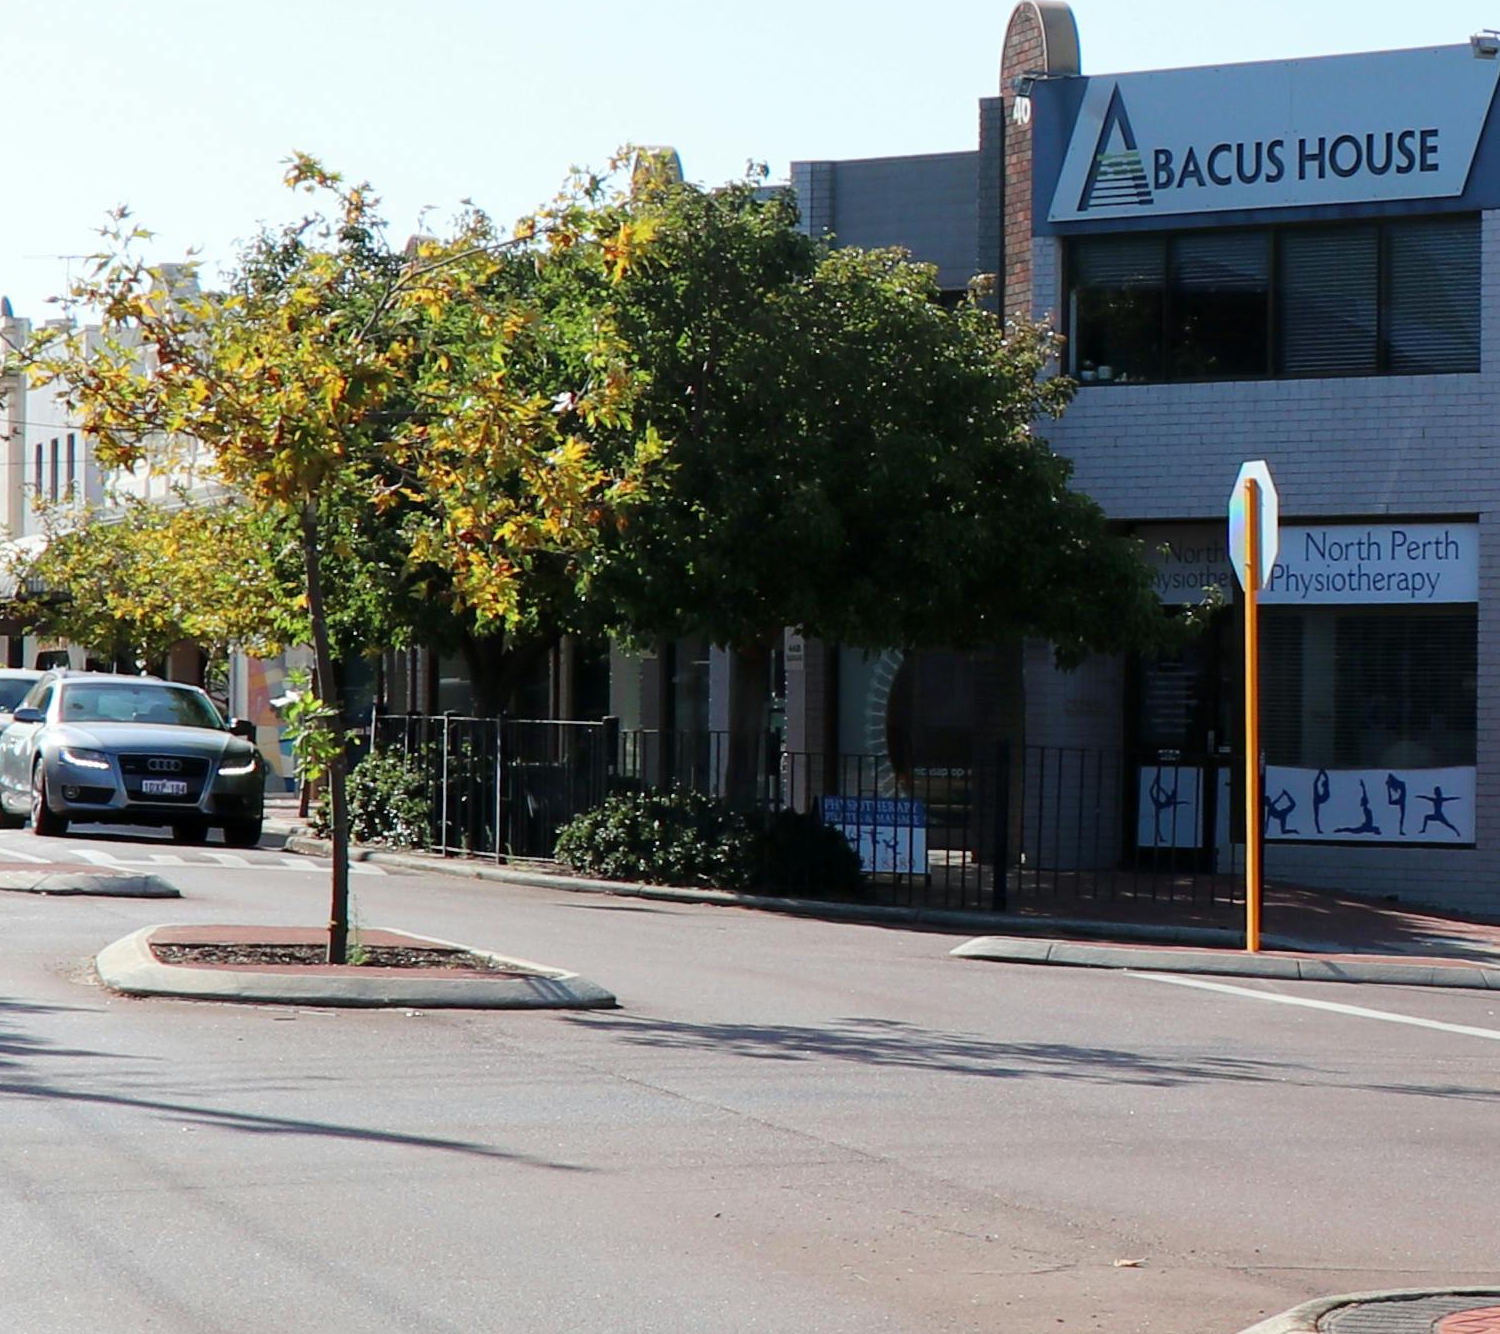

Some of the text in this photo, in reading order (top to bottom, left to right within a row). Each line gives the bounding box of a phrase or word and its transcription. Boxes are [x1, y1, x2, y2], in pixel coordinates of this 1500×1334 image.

[1012, 96, 1032, 125] 40
[1298, 129, 1439, 181] HOUSE
[1304, 530, 1460, 562] North Perth
[1270, 563, 1442, 598] Physiotherapy
